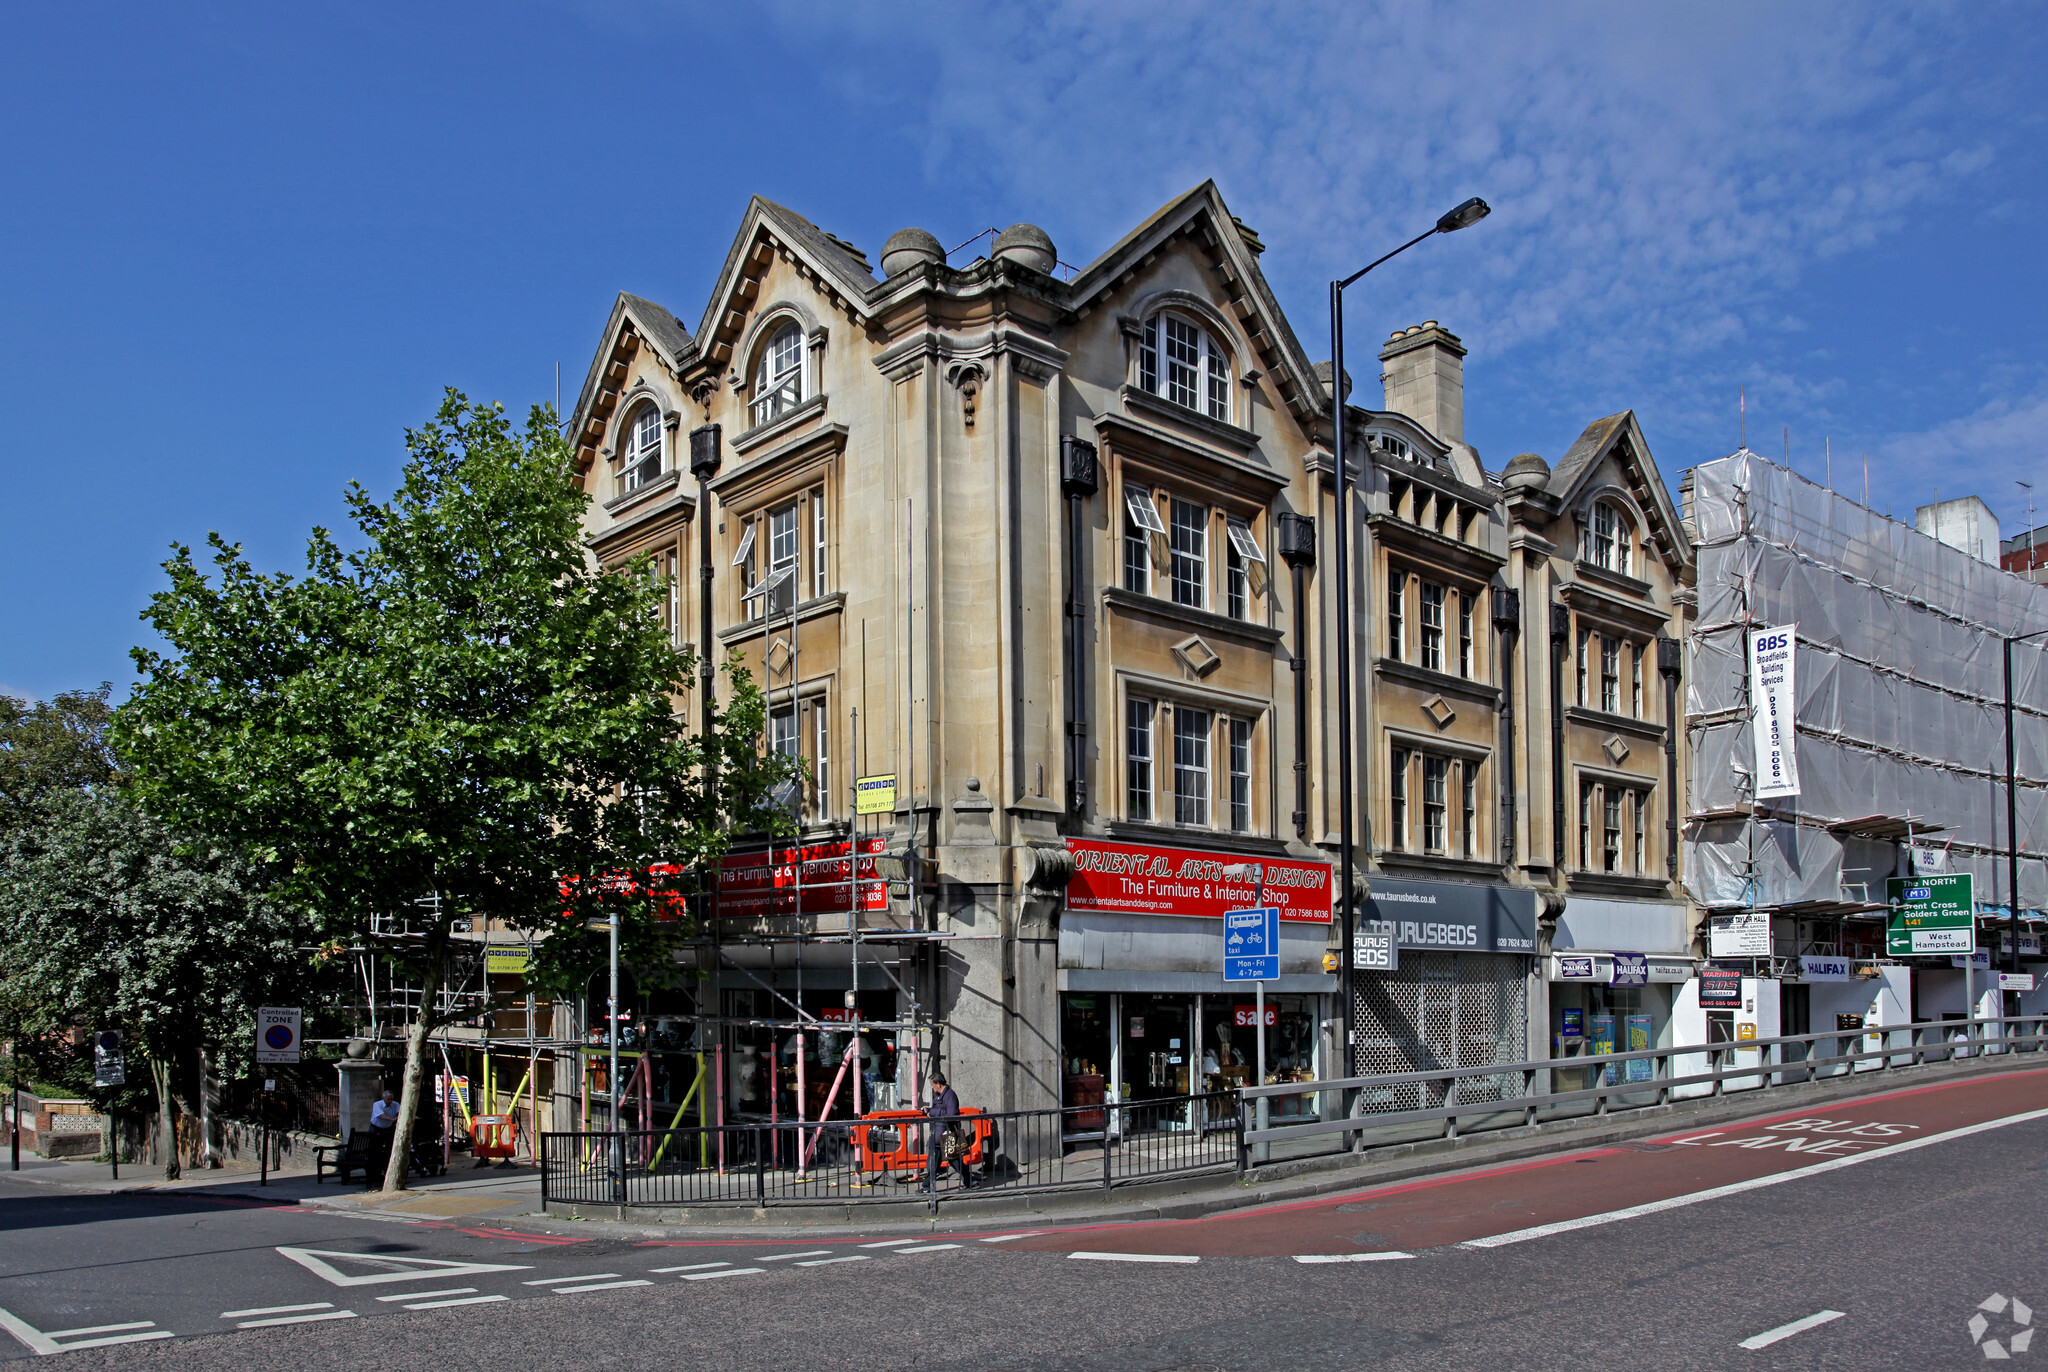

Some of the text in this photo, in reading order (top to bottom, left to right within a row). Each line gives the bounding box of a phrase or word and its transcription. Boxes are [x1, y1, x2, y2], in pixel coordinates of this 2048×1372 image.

[1757, 634, 1788, 652] BBS
[1756, 650, 1788, 664] Broadfields
[1762, 662, 1784, 674] Building
[1761, 674, 1784, 686] Services
[872, 842, 884, 852] 167
[738, 866, 782, 880] Furnitue
[784, 864, 792, 878] &
[800, 858, 839, 876] nteriors
[1073, 850, 1172, 878] ORIENTAL
[1176, 858, 1223, 882] ARTS
[1265, 866, 1326, 890] DESIGN
[1922, 878, 1957, 886] NORTH
[1120, 878, 1290, 907] The Furniture & Interiors Shop
[1370, 892, 1436, 904] www.taurusbeds.co.uk
[1070, 896, 1173, 910] www.orientalartsanddesign.com
[1285, 908, 1296, 916] 020
[1314, 910, 1329, 918] 8036
[1497, 938, 1507, 947] 020
[2018, 938, 2032, 948] EVEN
[1616, 965, 1646, 975] HALIFAX
[1808, 963, 1845, 975] HALIFAX
[1236, 1010, 1274, 1025] sae
[1764, 1118, 1920, 1136] BUS
[1671, 1132, 1888, 1156] LANE
